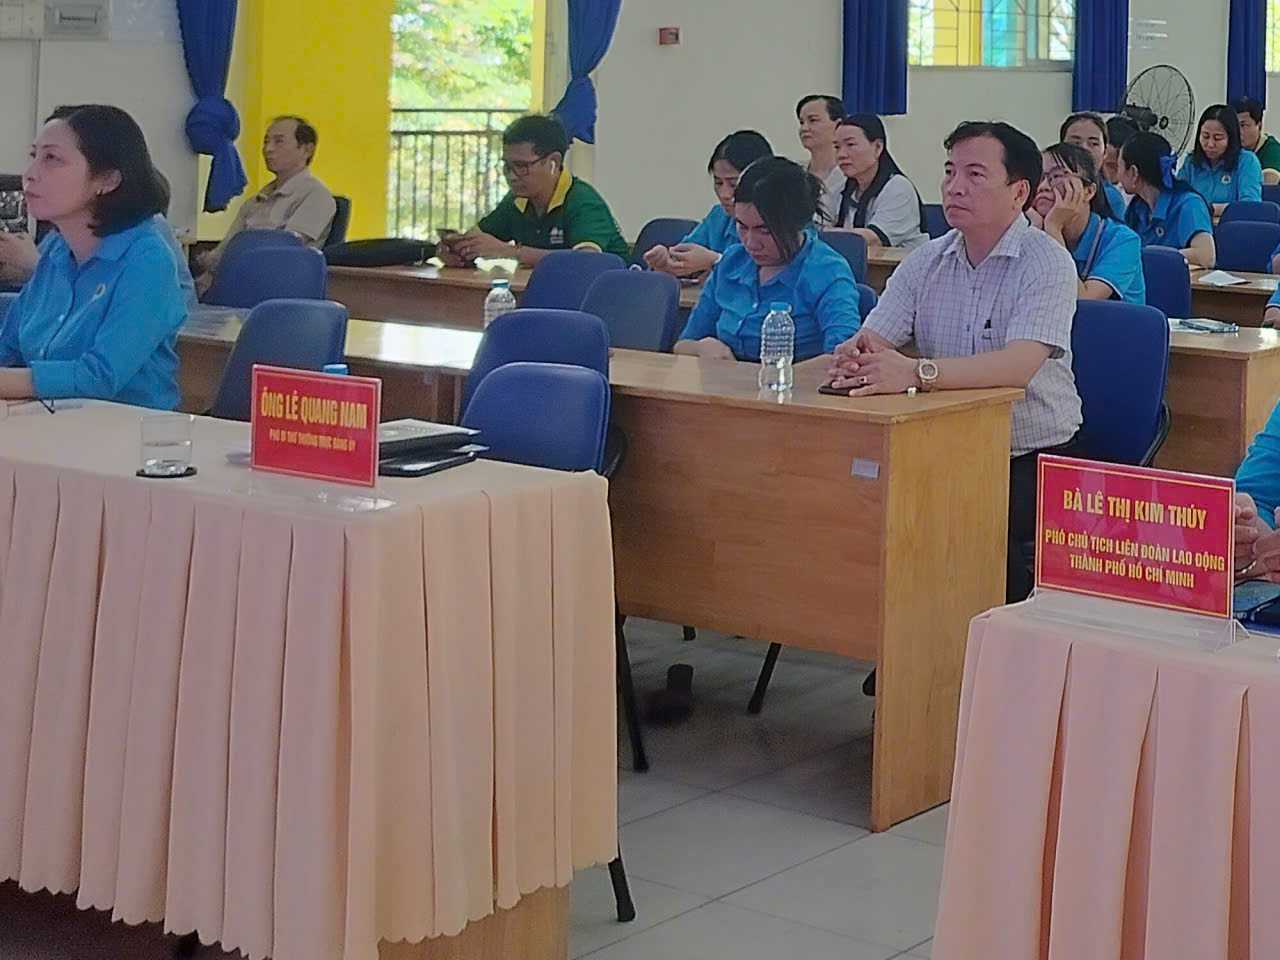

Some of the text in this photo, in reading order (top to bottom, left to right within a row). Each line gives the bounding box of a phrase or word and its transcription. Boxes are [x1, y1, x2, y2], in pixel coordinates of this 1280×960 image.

[300, 396, 338, 425] QUANG
[340, 401, 368, 429] NAM
[1063, 488, 1083, 511] BÀ
[1087, 491, 1104, 515] LÊ
[1107, 496, 1130, 523] THỊ
[1134, 500, 1164, 524] KIM
[1045, 528, 1225, 571] PHÓ CHỦ TỊCH LIÊN ĐOÀN LAO ĐỘNG
[1070, 553, 1103, 572] THÀNH
[1105, 557, 1126, 576] PHỐ
[1145, 565, 1163, 583] CHÍ
[1165, 570, 1195, 588] MINH
